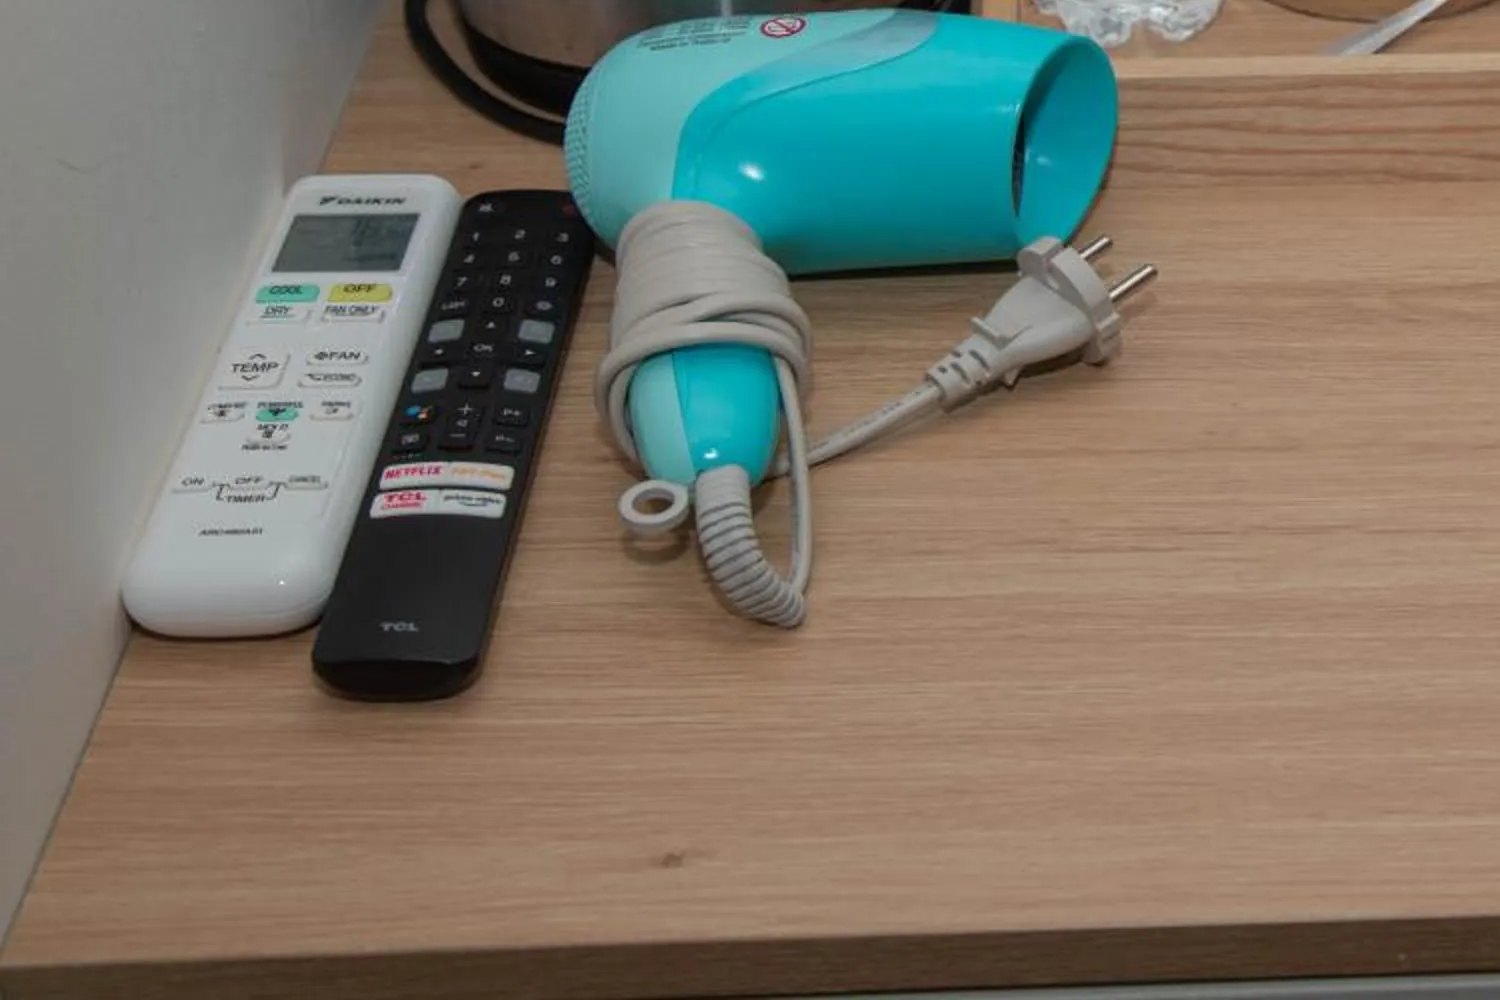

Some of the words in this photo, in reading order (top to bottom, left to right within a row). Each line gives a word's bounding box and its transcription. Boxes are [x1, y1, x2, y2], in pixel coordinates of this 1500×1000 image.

[337, 197, 406, 206] DAIKIN
[343, 284, 377, 294] OFF
[325, 306, 347, 314] FAN
[349, 306, 380, 314] ONLY
[328, 351, 362, 361] FAN
[231, 361, 280, 374] TEMP
[384, 465, 444, 480] NETFLIX
[181, 476, 206, 487] ON
[235, 475, 264, 485] OFF
[380, 621, 421, 632] TCL
